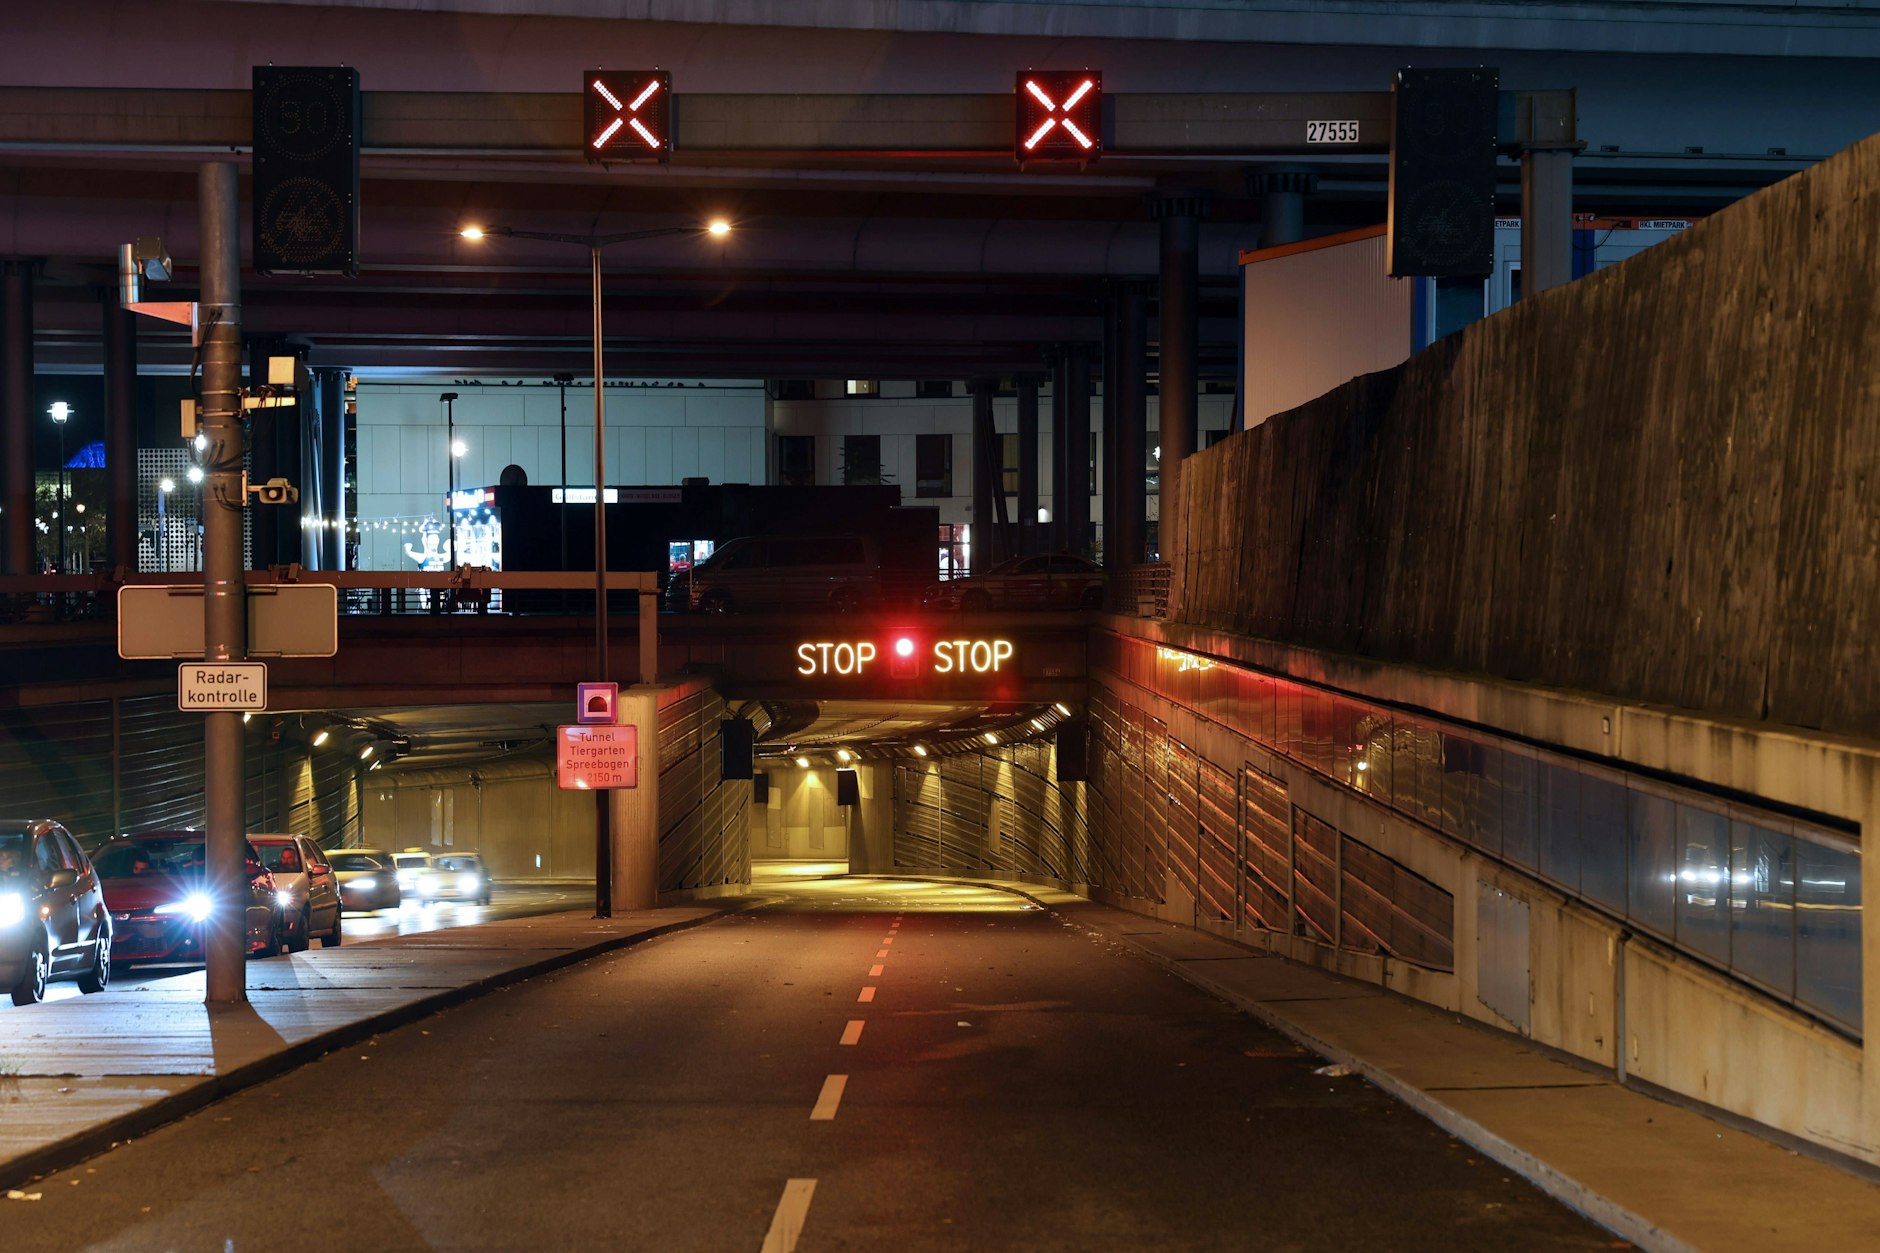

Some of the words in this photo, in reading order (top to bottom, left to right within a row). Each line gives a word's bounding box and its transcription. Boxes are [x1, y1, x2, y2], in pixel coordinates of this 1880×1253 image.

[1308, 122, 1358, 141] 27555
[1495, 220, 1520, 228] ETPARK
[1653, 221, 1686, 229] MIETPARK
[797, 642, 876, 675] STOP
[933, 640, 1013, 672] STOP
[196, 670, 249, 684] Radar-
[188, 689, 257, 703] kontrolle
[580, 732, 615, 742] Tunnel
[570, 746, 625, 757] Tiergarten
[566, 760, 629, 771] Spreebogen
[587, 773, 610, 782] 2150
